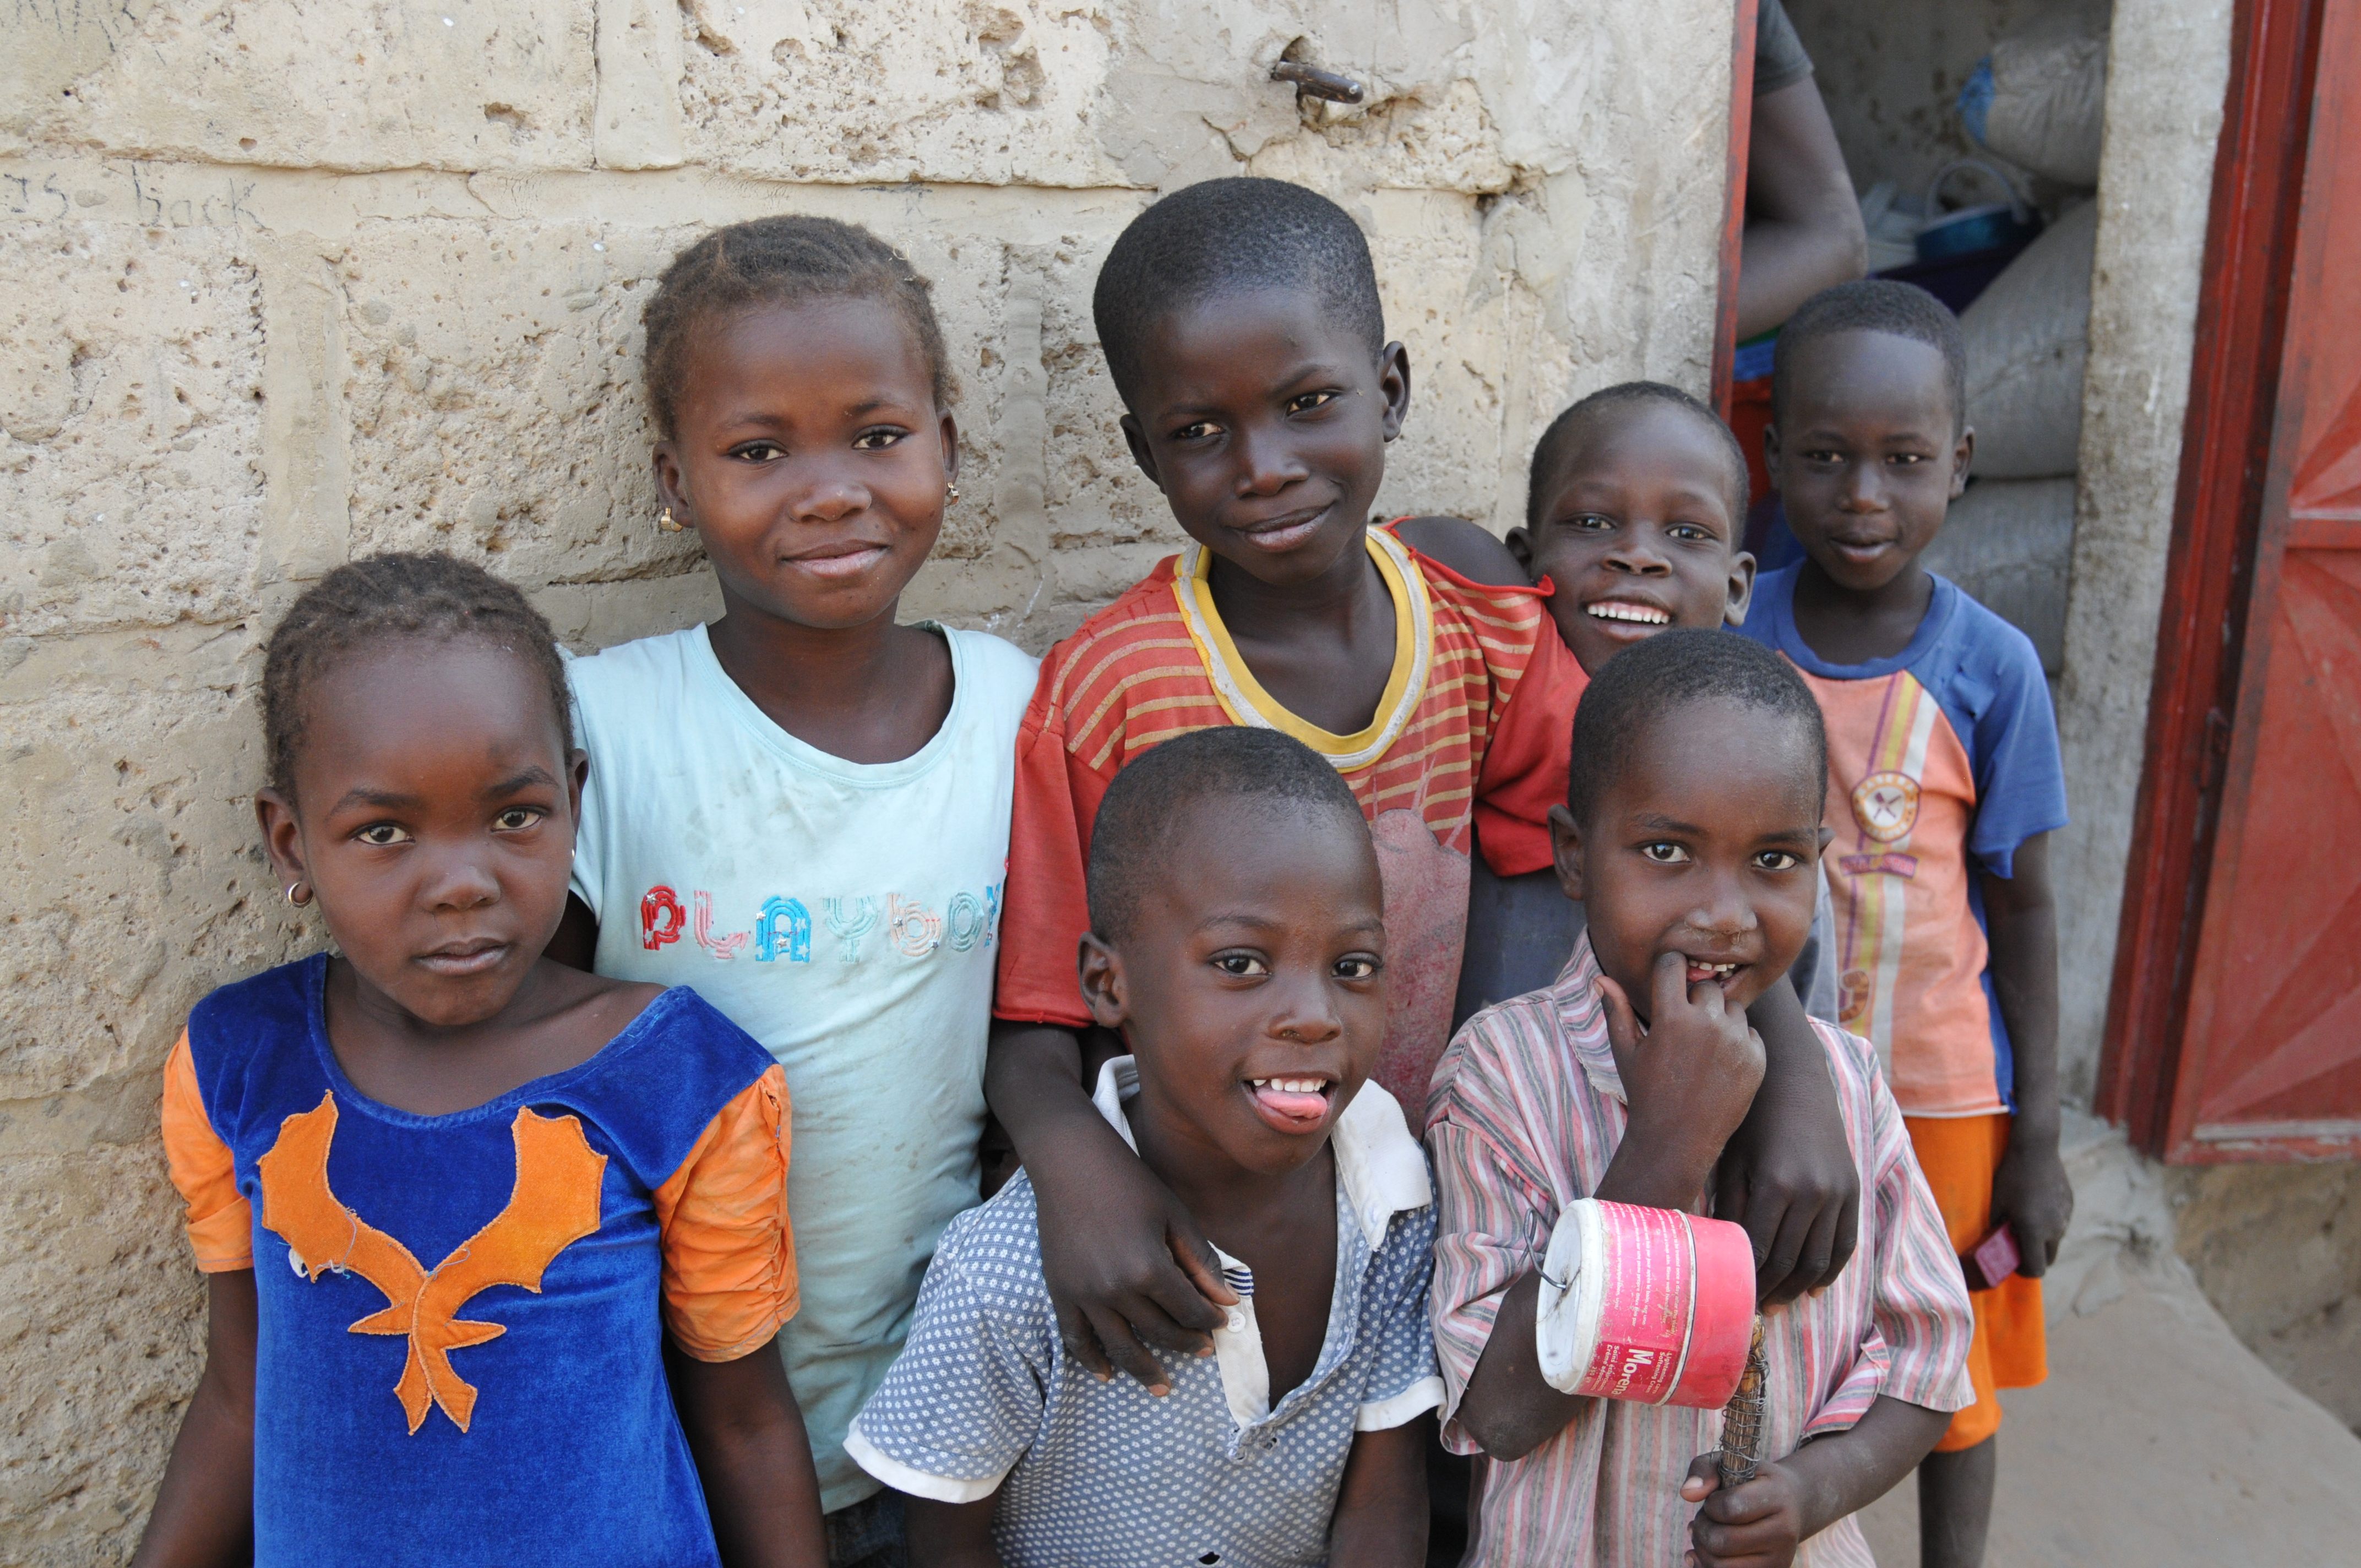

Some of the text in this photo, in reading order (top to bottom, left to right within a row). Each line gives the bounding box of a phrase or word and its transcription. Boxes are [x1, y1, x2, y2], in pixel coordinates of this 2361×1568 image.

[1603, 1344, 1613, 1364] Crème
[1611, 1345, 1620, 1363] Soins
[1657, 1352, 1672, 1382] Lightening
[1611, 1348, 1655, 1395] Morena
[1645, 1352, 1666, 1393] Softening Cream
